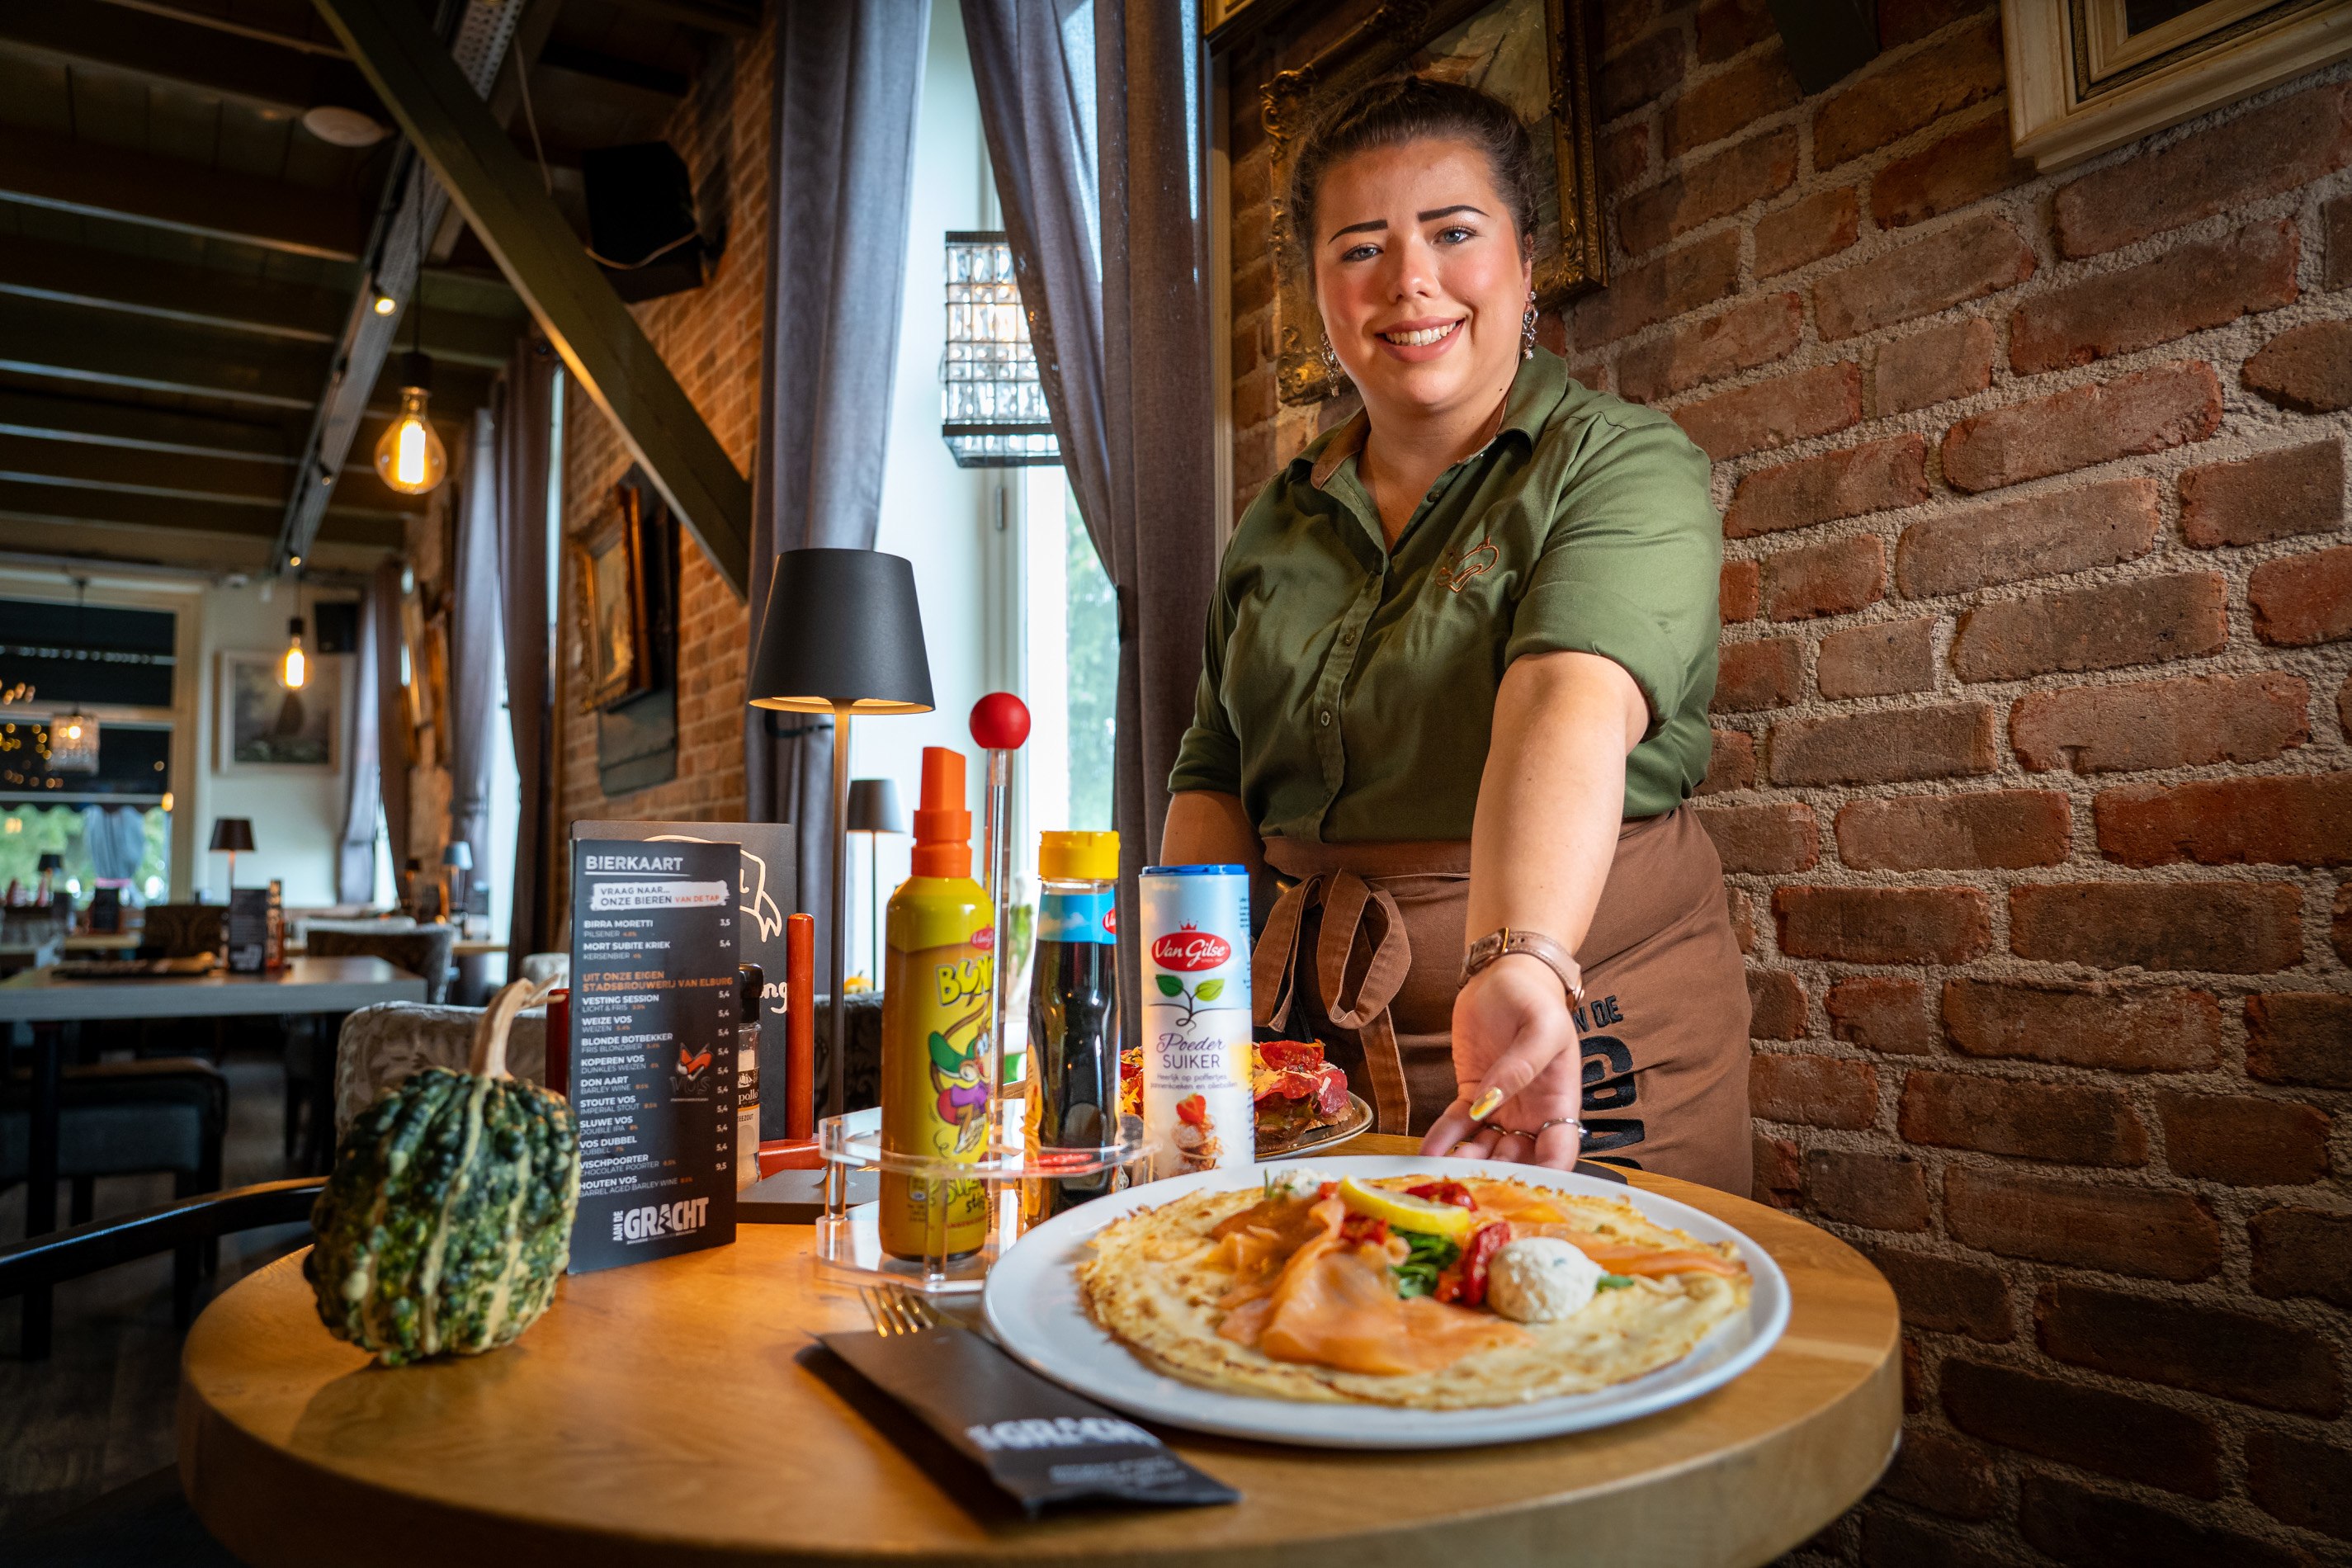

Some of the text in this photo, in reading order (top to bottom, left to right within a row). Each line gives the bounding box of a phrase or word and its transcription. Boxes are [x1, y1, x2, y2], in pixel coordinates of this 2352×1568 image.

[585, 855, 684, 871] BIERKAART
[637, 886, 670, 894] NAAR...
[601, 897, 631, 906] ONZE
[635, 895, 673, 905] BIEREN
[583, 919, 731, 928] BIRRA MORETTI 3,5
[583, 930, 620, 938] PILSENER
[583, 940, 731, 951] MORT SUBITE KRIEK 5,4
[1155, 938, 1226, 968] Van Gilse
[583, 952, 631, 961] KERSENBIER
[583, 971, 664, 982] UIT ONZE EIGEN
[582, 977, 733, 992] STADSBROUWERIJ VAN ELBURG
[582, 990, 730, 1005] VESTING SESSION 5,4
[582, 1005, 603, 1013] LICHT
[1590, 994, 1623, 1028] DE
[582, 1009, 730, 1026] WEIZE VOS 5,4
[582, 1025, 612, 1033] WEIZEN
[581, 1028, 730, 1046] BLONDE BOTBEKKER 5,4
[1156, 1032, 1226, 1054] Poeder
[581, 1045, 598, 1054] FRIS
[599, 1042, 643, 1053] BLONDBIER
[581, 1047, 730, 1067] KOPEREN VOS 5,4
[1163, 1054, 1221, 1070] SUIKER
[581, 1065, 617, 1074] DUNKLES
[618, 1062, 647, 1071] WEIZEN
[580, 1066, 729, 1088] DON AART 5,4
[580, 1086, 610, 1095] BARLEY
[611, 1084, 631, 1092] WINE
[580, 1086, 728, 1108] STOUTE VOS 5,4
[739, 1089, 758, 1105] pollo
[580, 1105, 616, 1116] IMPERIAL
[616, 1103, 640, 1112] STOUT
[580, 1105, 728, 1129] SLUWE VOS 5,4
[738, 1114, 753, 1122] EEZOUT
[579, 1125, 612, 1136] DOUBLE
[612, 1124, 626, 1132] IPA
[579, 1124, 728, 1150] VOS DUBBEL 5,4
[579, 1146, 612, 1157] DUBBEL
[579, 1143, 728, 1170] VISCHPOORTER 5,4
[626, 1160, 659, 1172] POORTER
[579, 1162, 727, 1190] HOUTEN VOS 9,5
[579, 1188, 609, 1198] BARREL
[610, 1184, 631, 1194] AGED
[632, 1180, 659, 1192] BARLEY
[660, 1177, 678, 1187] WINE
[613, 1210, 623, 1222] DE
[624, 1197, 709, 1240] GRACHT
[613, 1223, 623, 1241] AAN
